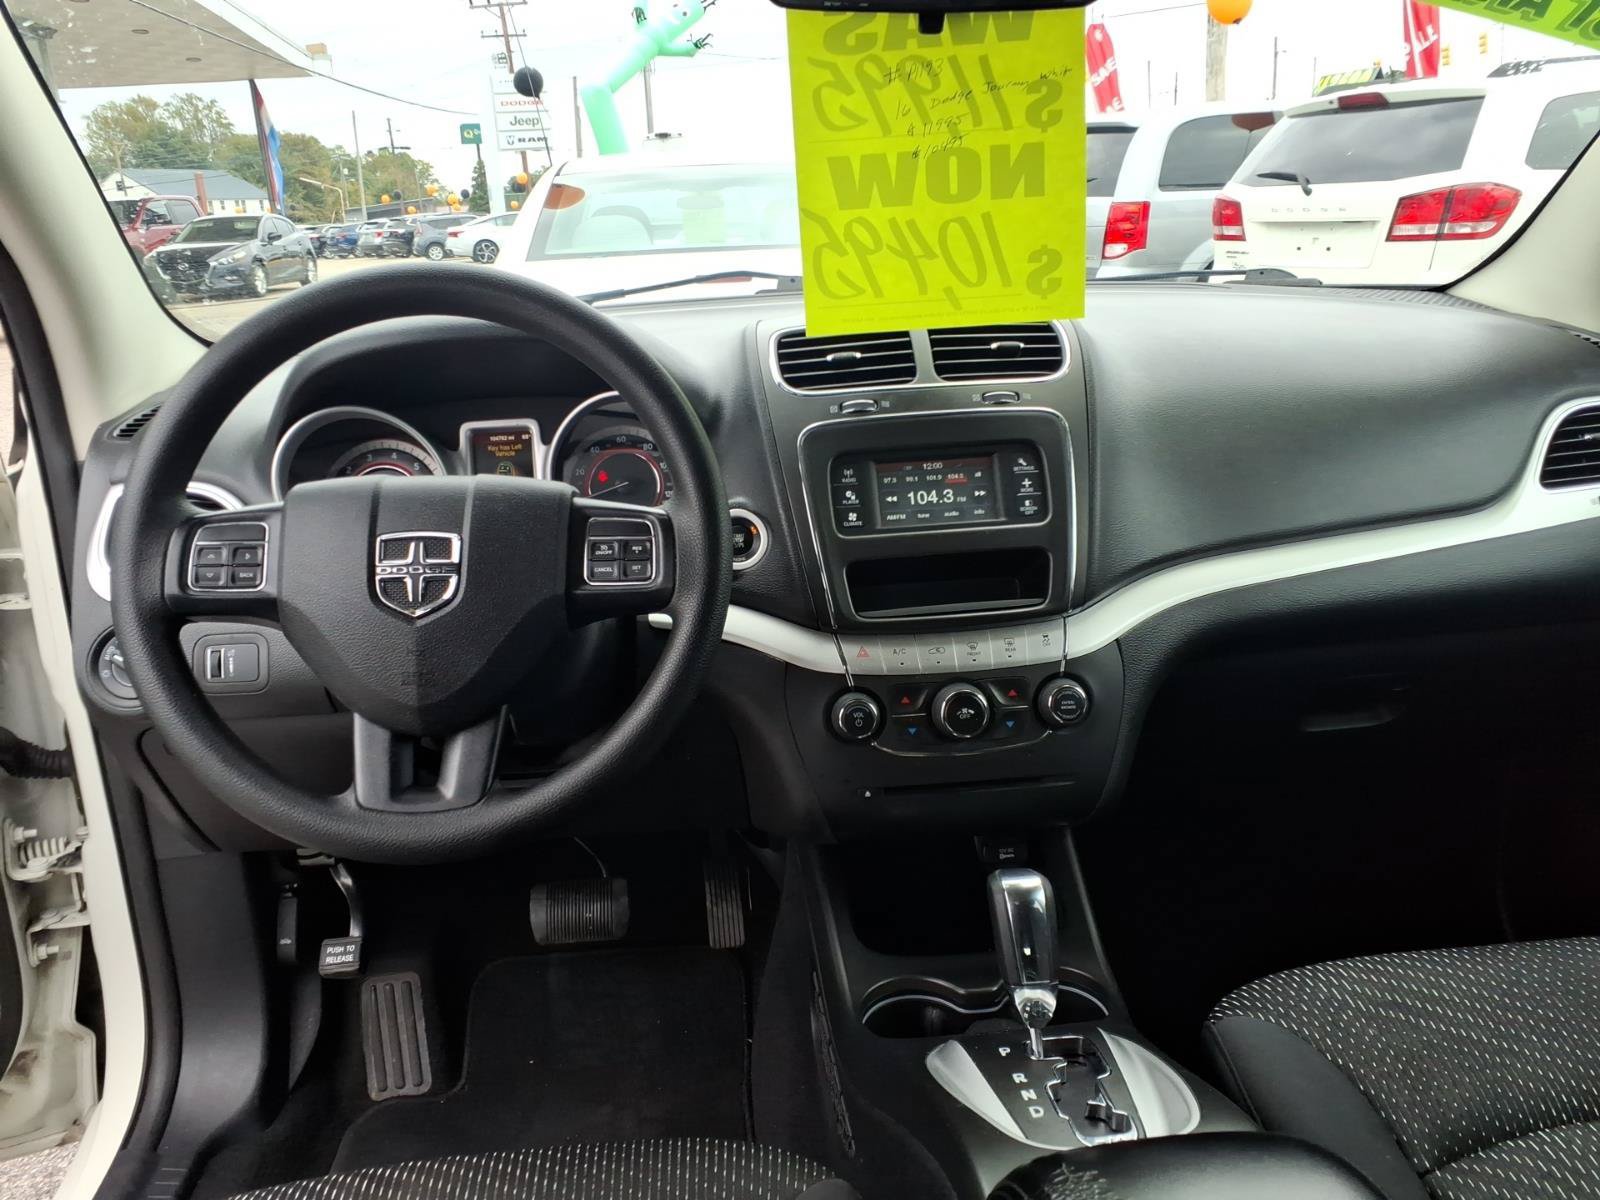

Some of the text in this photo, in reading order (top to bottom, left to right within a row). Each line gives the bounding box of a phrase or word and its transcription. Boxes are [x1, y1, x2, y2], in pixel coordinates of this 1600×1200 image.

[509, 115, 540, 127] Jeep
[413, 462, 421, 471] 5
[922, 462, 943, 470] 12:00
[907, 488, 954, 505] 104.3
[376, 565, 457, 574] DODGE
[346, 944, 355, 952] TO
[326, 954, 353, 964] RELEASE
[999, 1047, 1010, 1056] P
[1012, 1073, 1027, 1083] R
[1021, 1089, 1037, 1100] N
[1029, 1107, 1044, 1118] D
